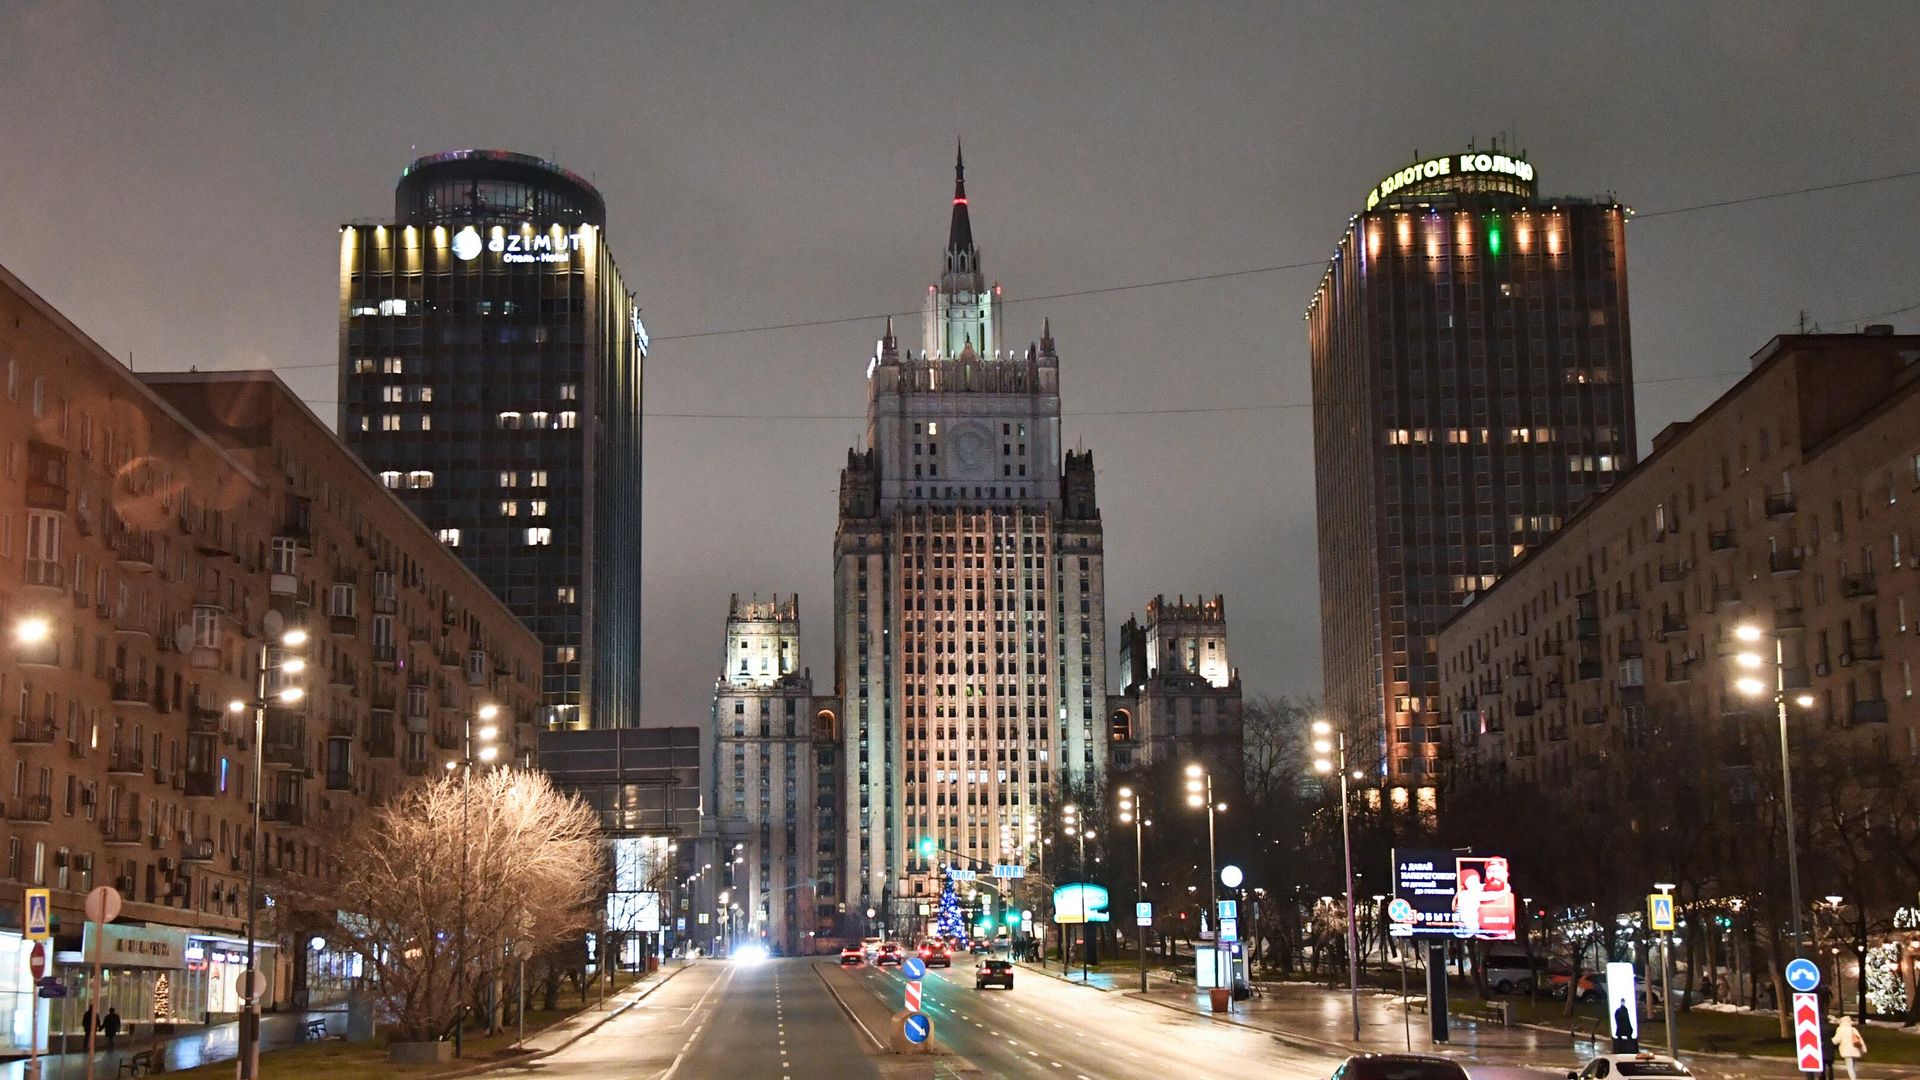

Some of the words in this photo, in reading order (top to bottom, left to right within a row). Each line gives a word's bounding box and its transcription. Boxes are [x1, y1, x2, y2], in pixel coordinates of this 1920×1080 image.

[1381, 157, 1450, 198] ЗОЛОТОЕ
[1460, 154, 1534, 181] КОЛЬЦО
[541, 253, 568, 262] Hotel
[1400, 862, 1407, 870] А
[1408, 862, 1433, 871] ДАВАЙ
